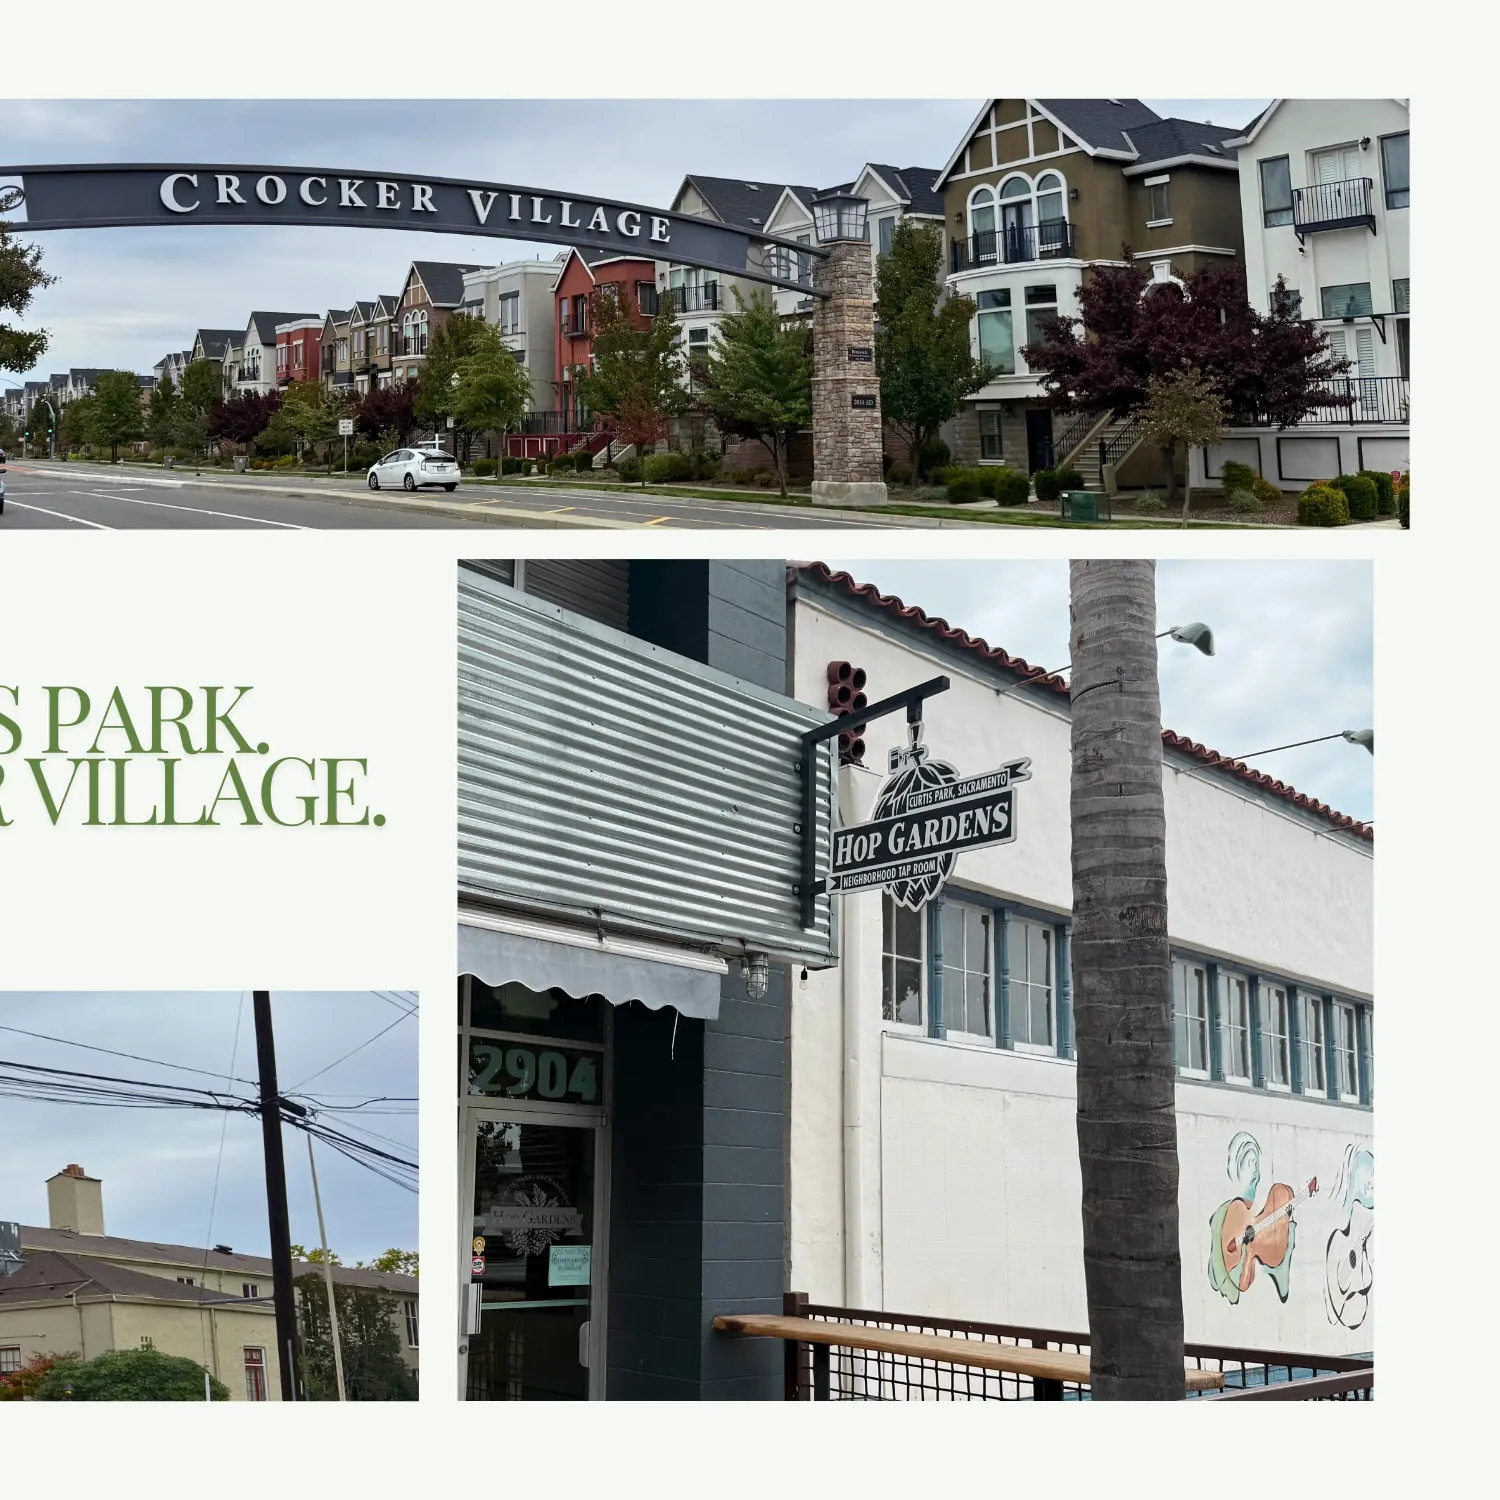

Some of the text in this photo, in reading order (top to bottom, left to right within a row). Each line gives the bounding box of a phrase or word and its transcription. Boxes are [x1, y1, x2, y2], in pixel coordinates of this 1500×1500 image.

[159, 173, 671, 243] CROCKER VILLAGE
[909, 773, 1007, 809] CURTIS PARK, SACRAMENTO
[835, 801, 1009, 867] HOP GARDENS
[843, 859, 936, 888] NEIGHBORHOOD TAP ROOM
[471, 1044, 598, 1102] 2904
[522, 1210, 576, 1224] GARDENS
